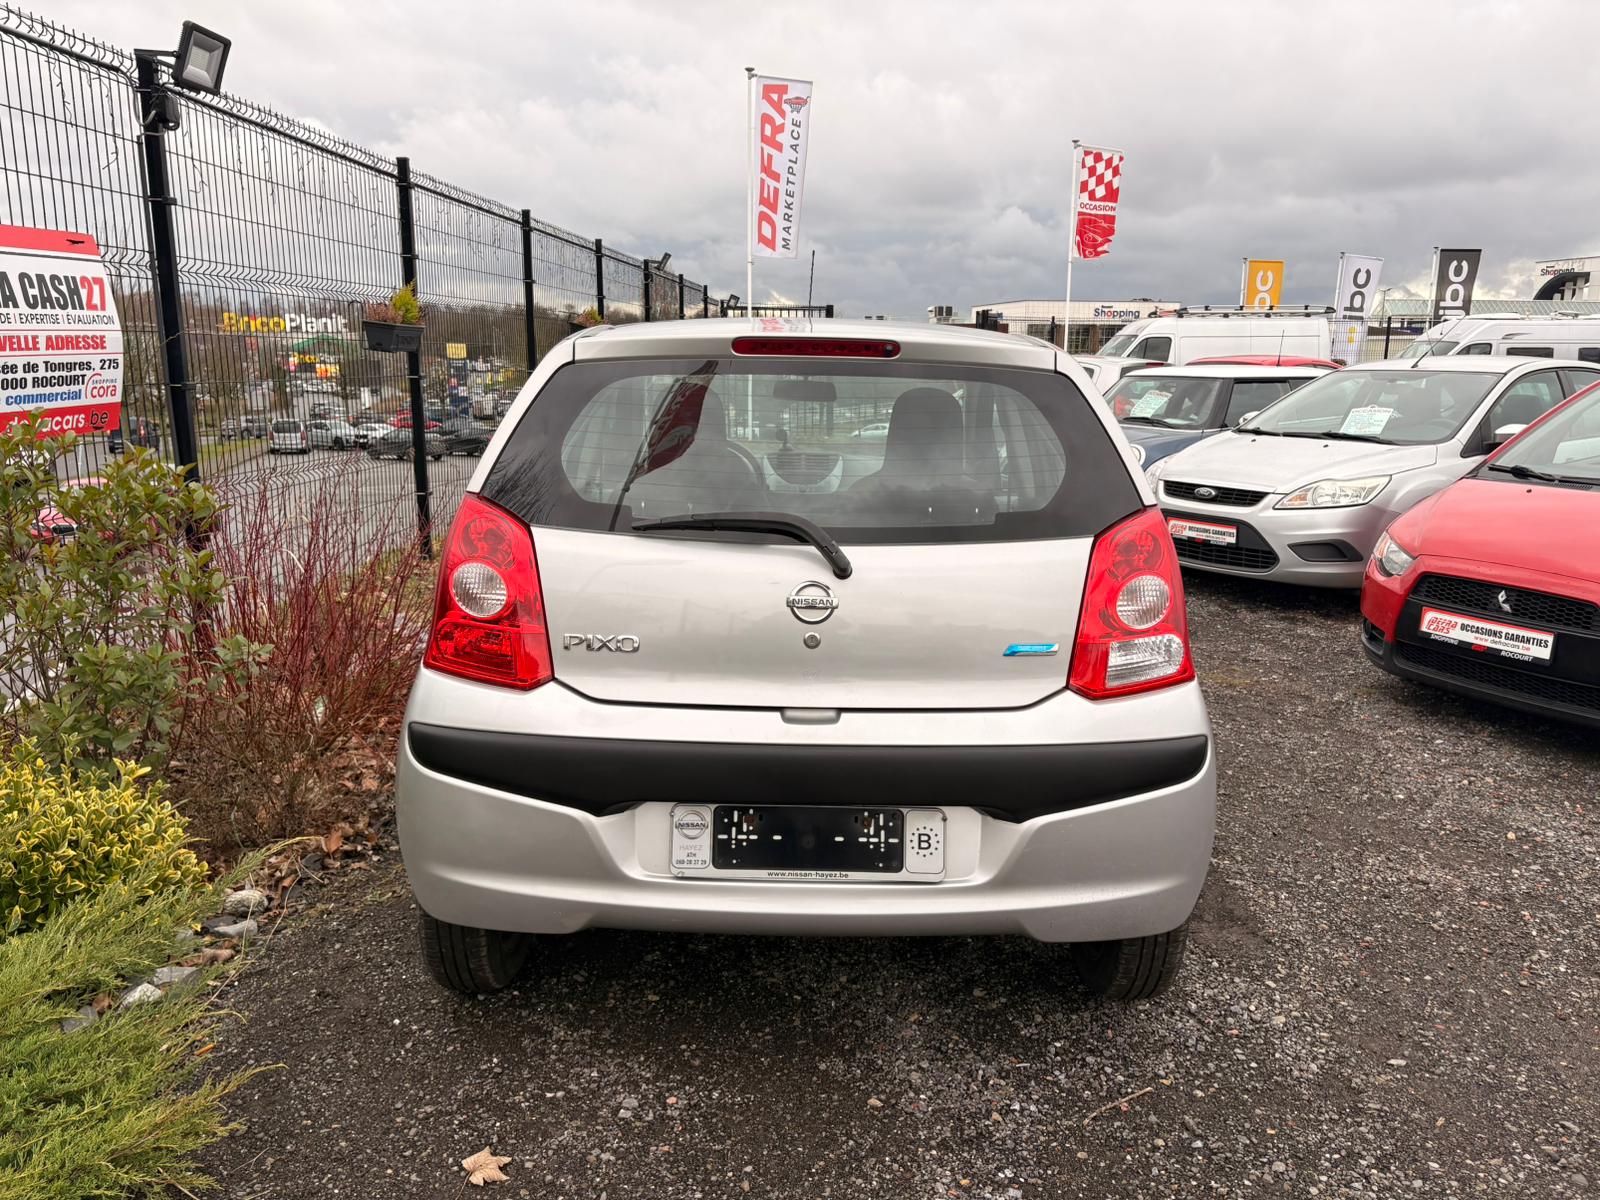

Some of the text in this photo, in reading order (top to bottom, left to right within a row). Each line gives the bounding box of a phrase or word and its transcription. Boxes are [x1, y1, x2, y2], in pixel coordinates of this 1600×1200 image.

[756, 83, 789, 252] DEFRA
[781, 117, 802, 251] MARKETPLACE
[1079, 201, 1117, 212] OCCASION
[0, 270, 20, 309] A
[1254, 270, 1274, 311] bc
[18, 313, 61, 325] EXPERTISE
[66, 312, 115, 326] ÉVALUATION
[1094, 308, 1140, 320] Shopping
[45, 334, 107, 351] ADRESSE
[0, 358, 119, 375] ée de Tongres, 275
[32, 374, 87, 389] ROCOURT
[5, 388, 82, 406] commercial
[90, 384, 117, 399] cora
[792, 597, 834, 608] NISSAN
[563, 633, 640, 653] PIXO
[1460, 622, 1504, 640] OCCASIONS
[1504, 632, 1550, 649] GARANTIES
[1501, 650, 1534, 662] ROCOURT
[917, 832, 933, 850] B
[767, 871, 849, 879] www.nissan-hayez.be
